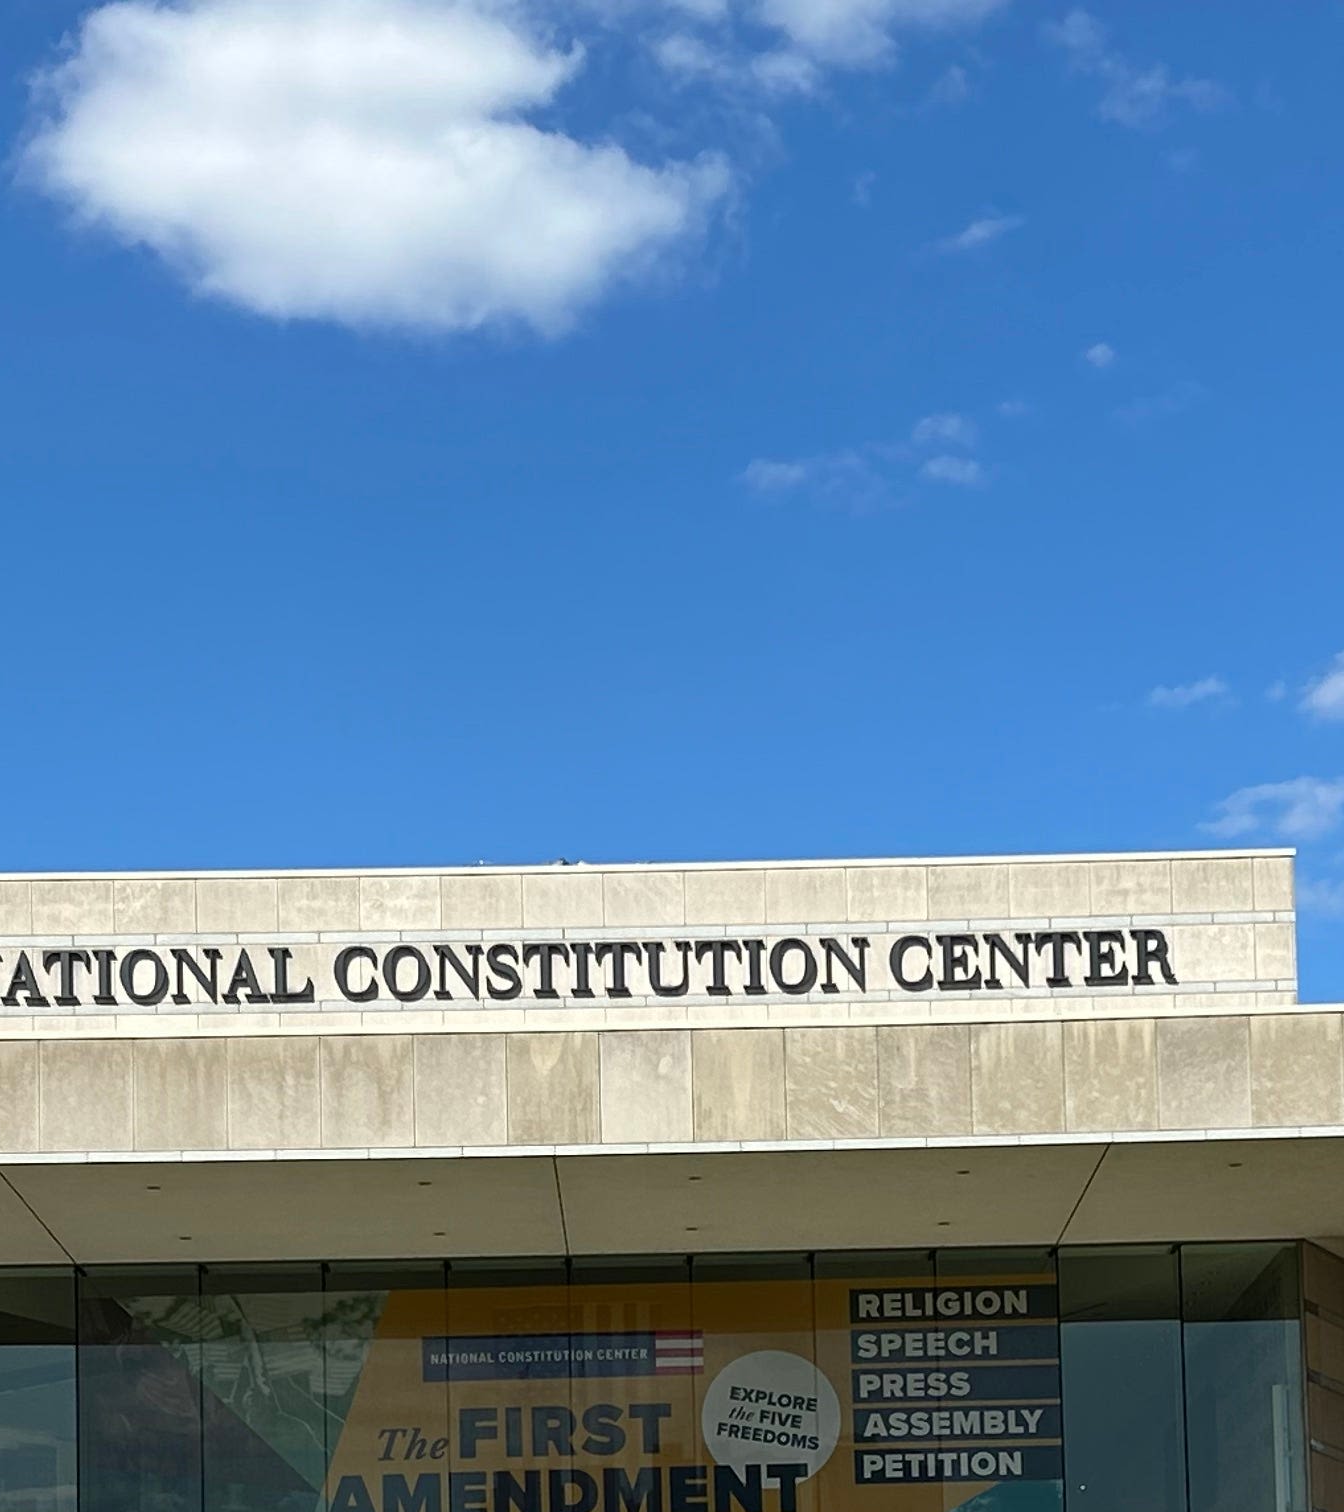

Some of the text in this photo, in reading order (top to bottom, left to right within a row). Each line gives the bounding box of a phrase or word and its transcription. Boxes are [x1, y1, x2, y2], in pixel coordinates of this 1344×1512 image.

[334, 937, 869, 1003] CONSTITUTION
[888, 930, 1179, 992] CENTER
[858, 1290, 1028, 1318] RELIGION
[431, 1348, 648, 1365] NATIONAL CONSTITUTION CENTER
[857, 1331, 998, 1358] SPEECH
[729, 1386, 818, 1412] EXPLORE
[859, 1372, 971, 1399] PRESS
[728, 1405, 803, 1429] the FIVE
[863, 1409, 1044, 1437] ASSEMBLY
[378, 1403, 672, 1462] The FIRST
[717, 1422, 820, 1451] FREEDOMS
[863, 1451, 1023, 1479] PETITION
